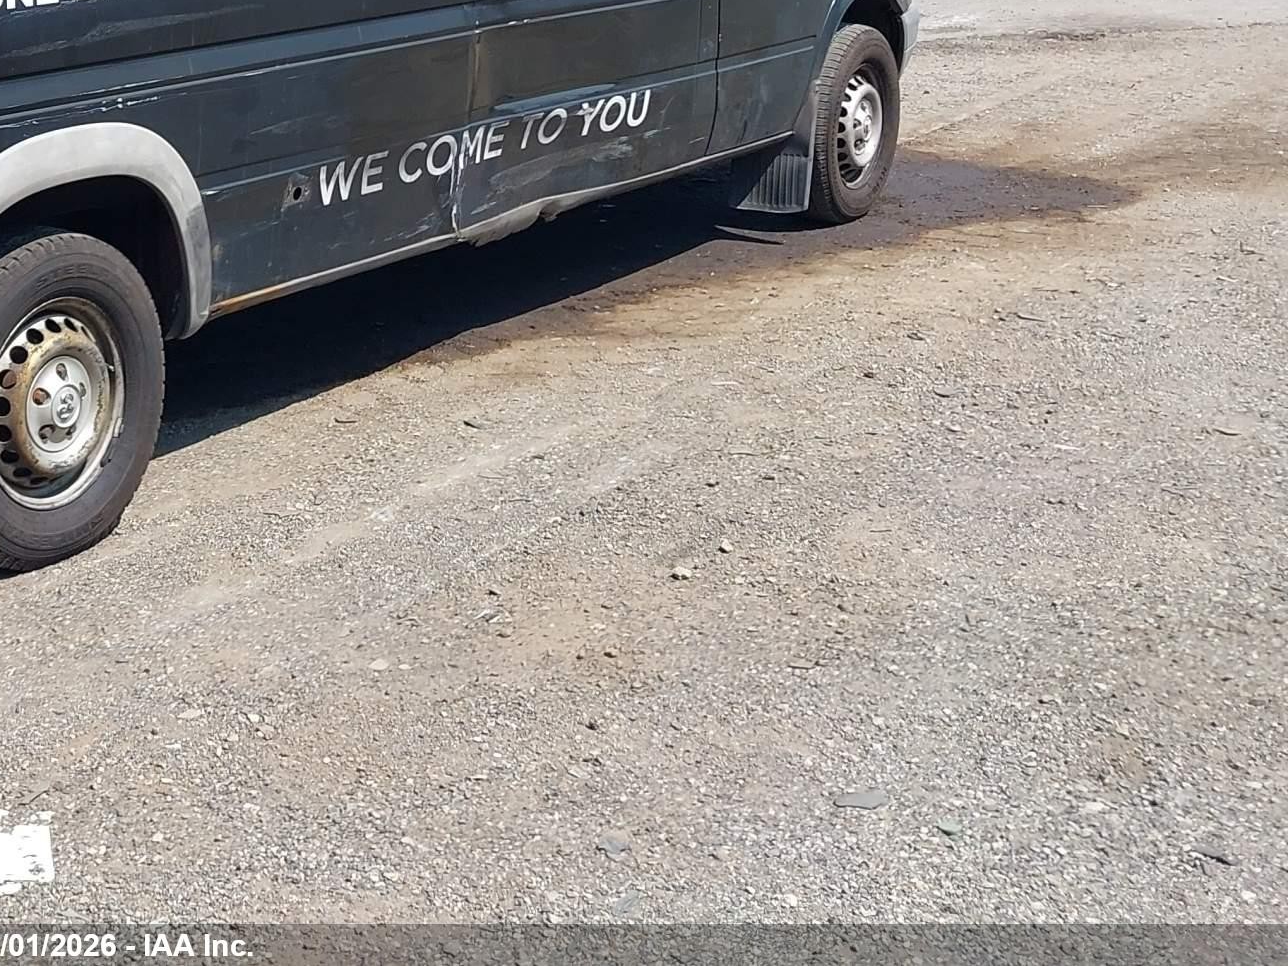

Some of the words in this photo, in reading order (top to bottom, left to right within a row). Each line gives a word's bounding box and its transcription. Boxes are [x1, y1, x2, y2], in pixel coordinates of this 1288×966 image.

[319, 150, 389, 206] WE
[398, 122, 509, 184] COME
[519, 108, 567, 150] TO
[578, 89, 651, 136] YOU
